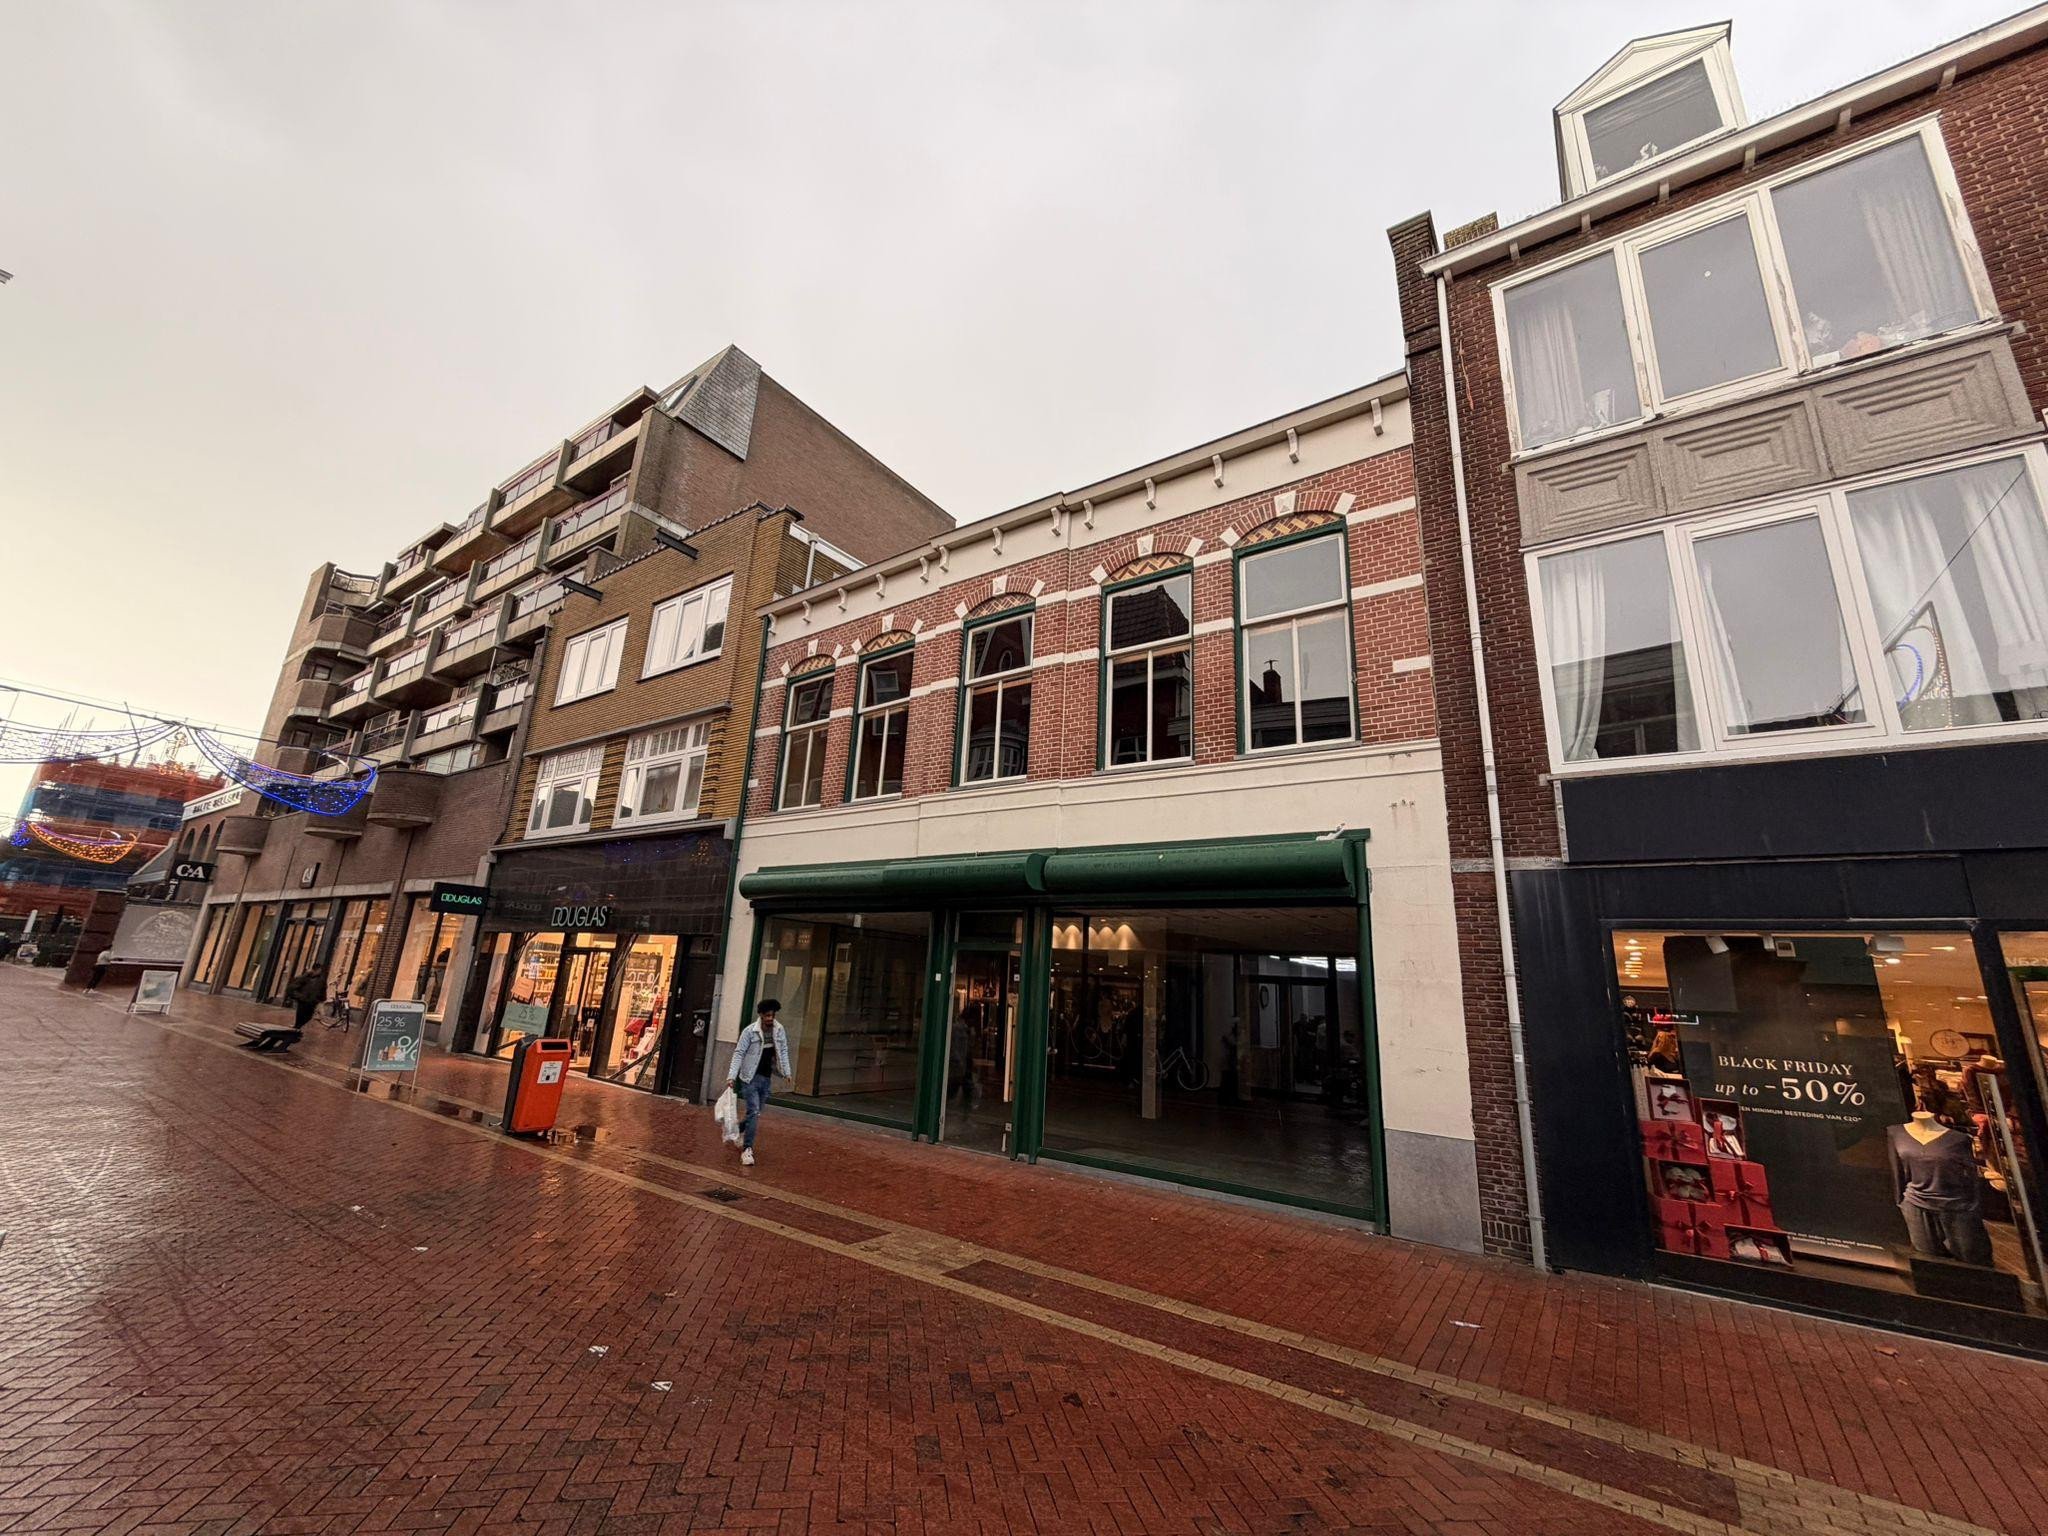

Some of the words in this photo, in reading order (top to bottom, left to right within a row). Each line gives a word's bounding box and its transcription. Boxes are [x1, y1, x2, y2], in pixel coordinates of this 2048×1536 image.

[176, 863, 205, 879] C&A
[441, 893, 482, 905] DOUGLAS
[551, 905, 608, 928] DOUGLAS
[1718, 1055, 1778, 1070] BLACK
[1783, 1060, 1853, 1076] FRIDAY
[1714, 1083, 1736, 1096] up
[1742, 1083, 1759, 1096] to
[1764, 1077, 1865, 1106] -50%
[1752, 1107, 1783, 1115] MINIMUM
[1785, 1110, 1824, 1119] BESTEDING
